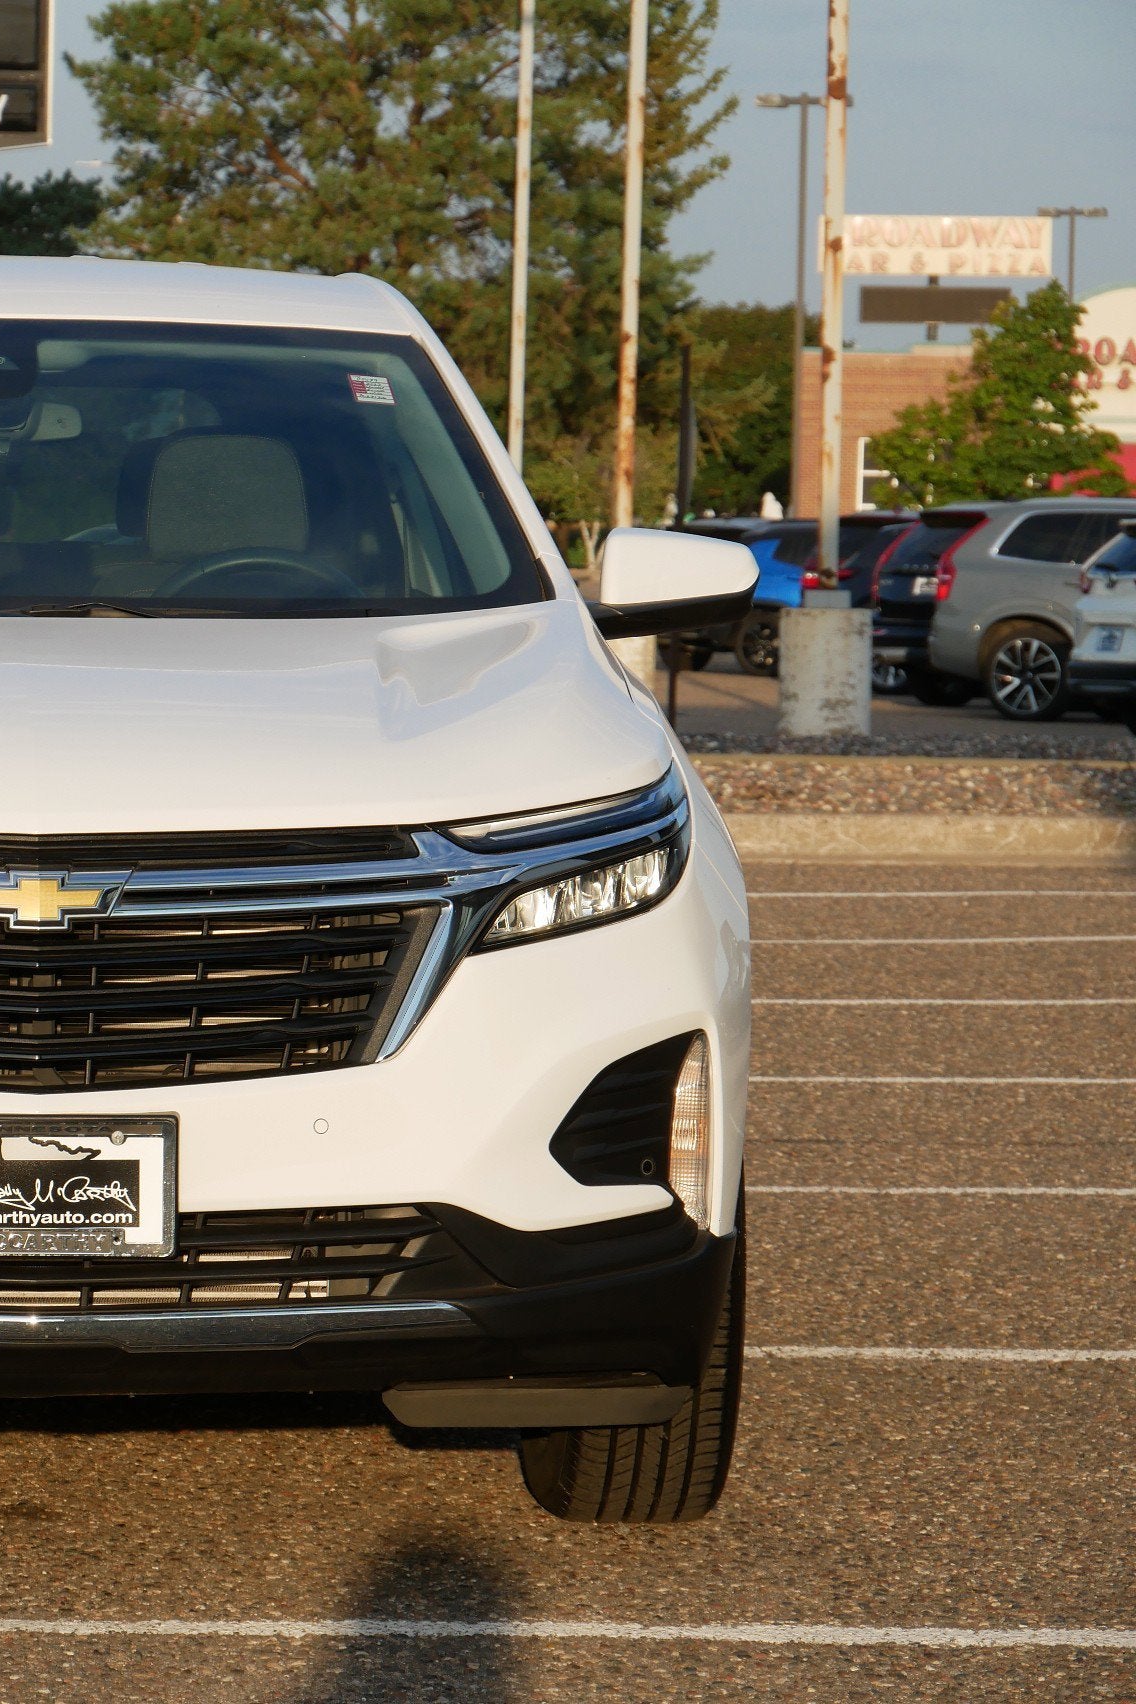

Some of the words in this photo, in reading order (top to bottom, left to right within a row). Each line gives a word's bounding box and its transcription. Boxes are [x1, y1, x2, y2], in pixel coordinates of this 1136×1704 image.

[850, 217, 1046, 249] ROADWAY
[847, 251, 889, 273] AR
[948, 252, 1048, 274] PIZZA
